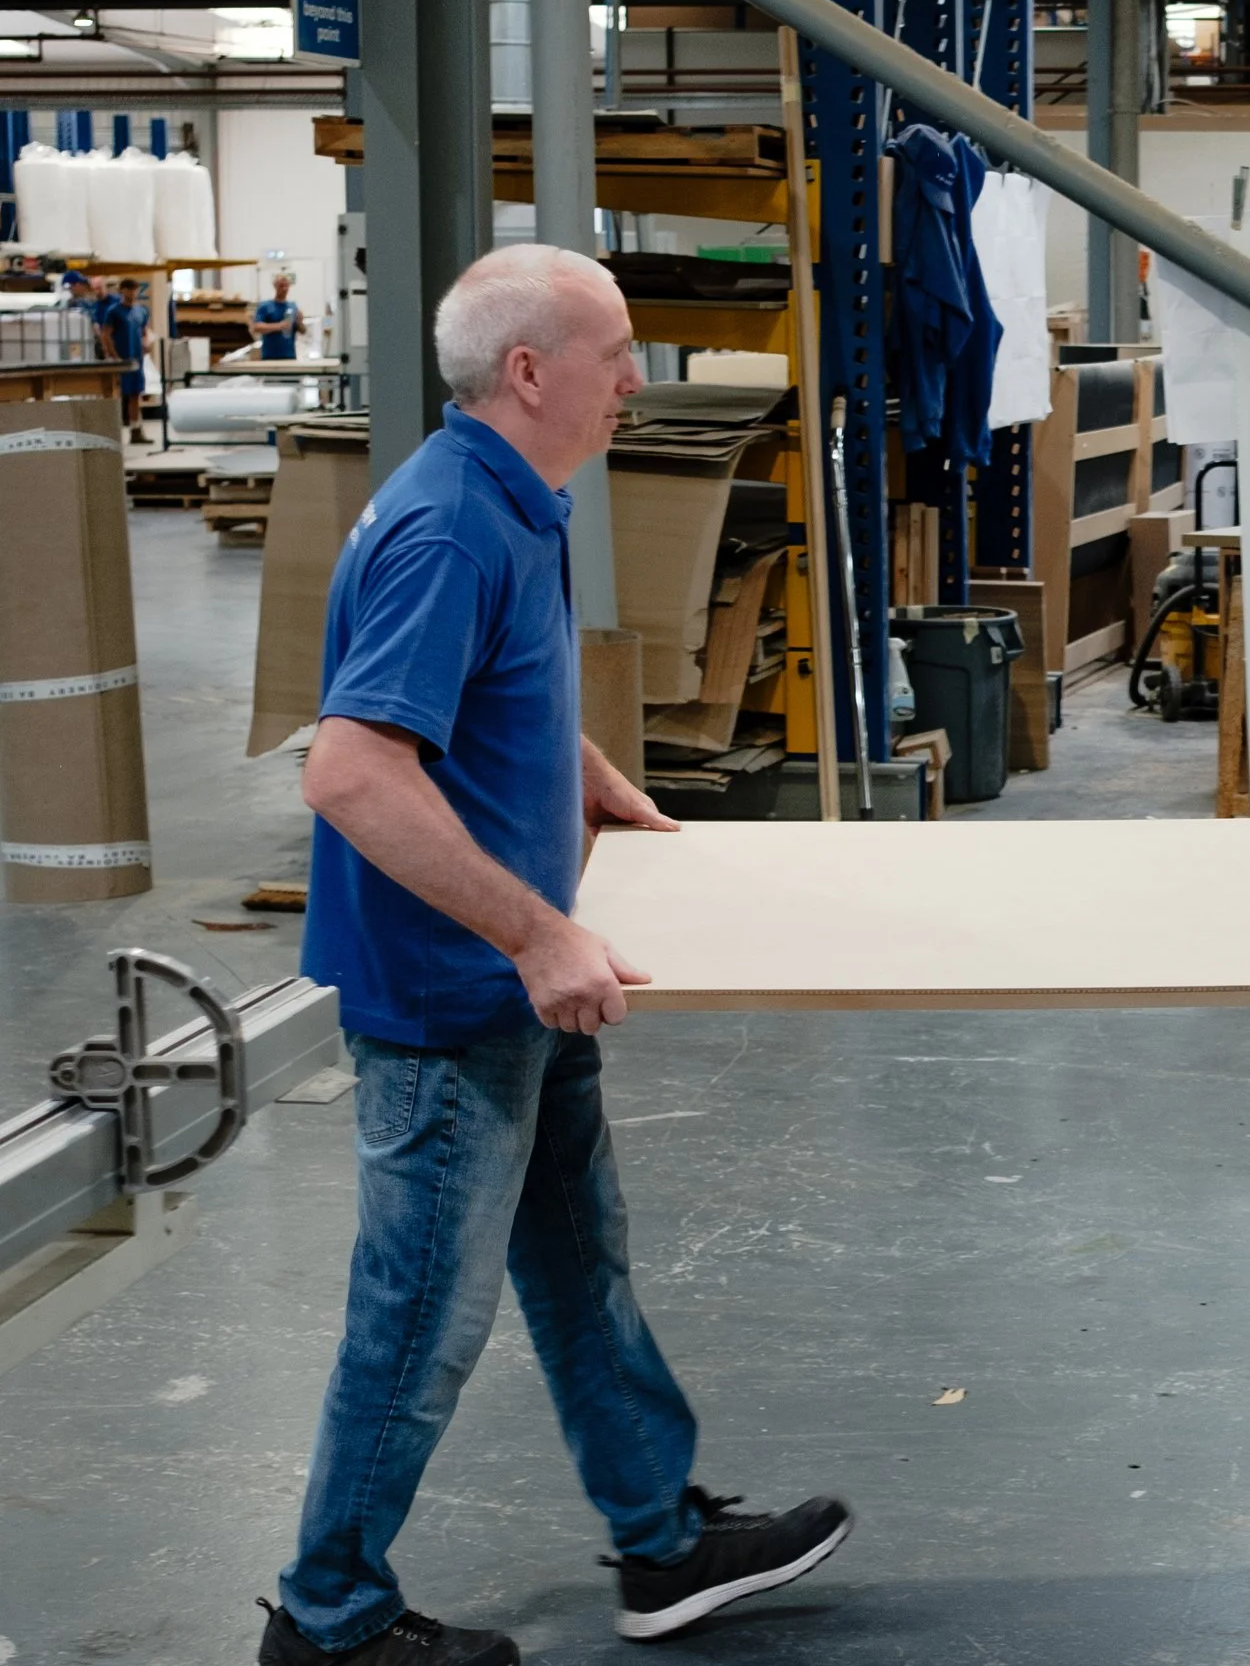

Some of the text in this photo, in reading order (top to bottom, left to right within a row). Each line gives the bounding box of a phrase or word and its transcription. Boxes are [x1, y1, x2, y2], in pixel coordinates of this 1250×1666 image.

[303, 1, 353, 24] beyond this
[317, 26, 340, 43] point
